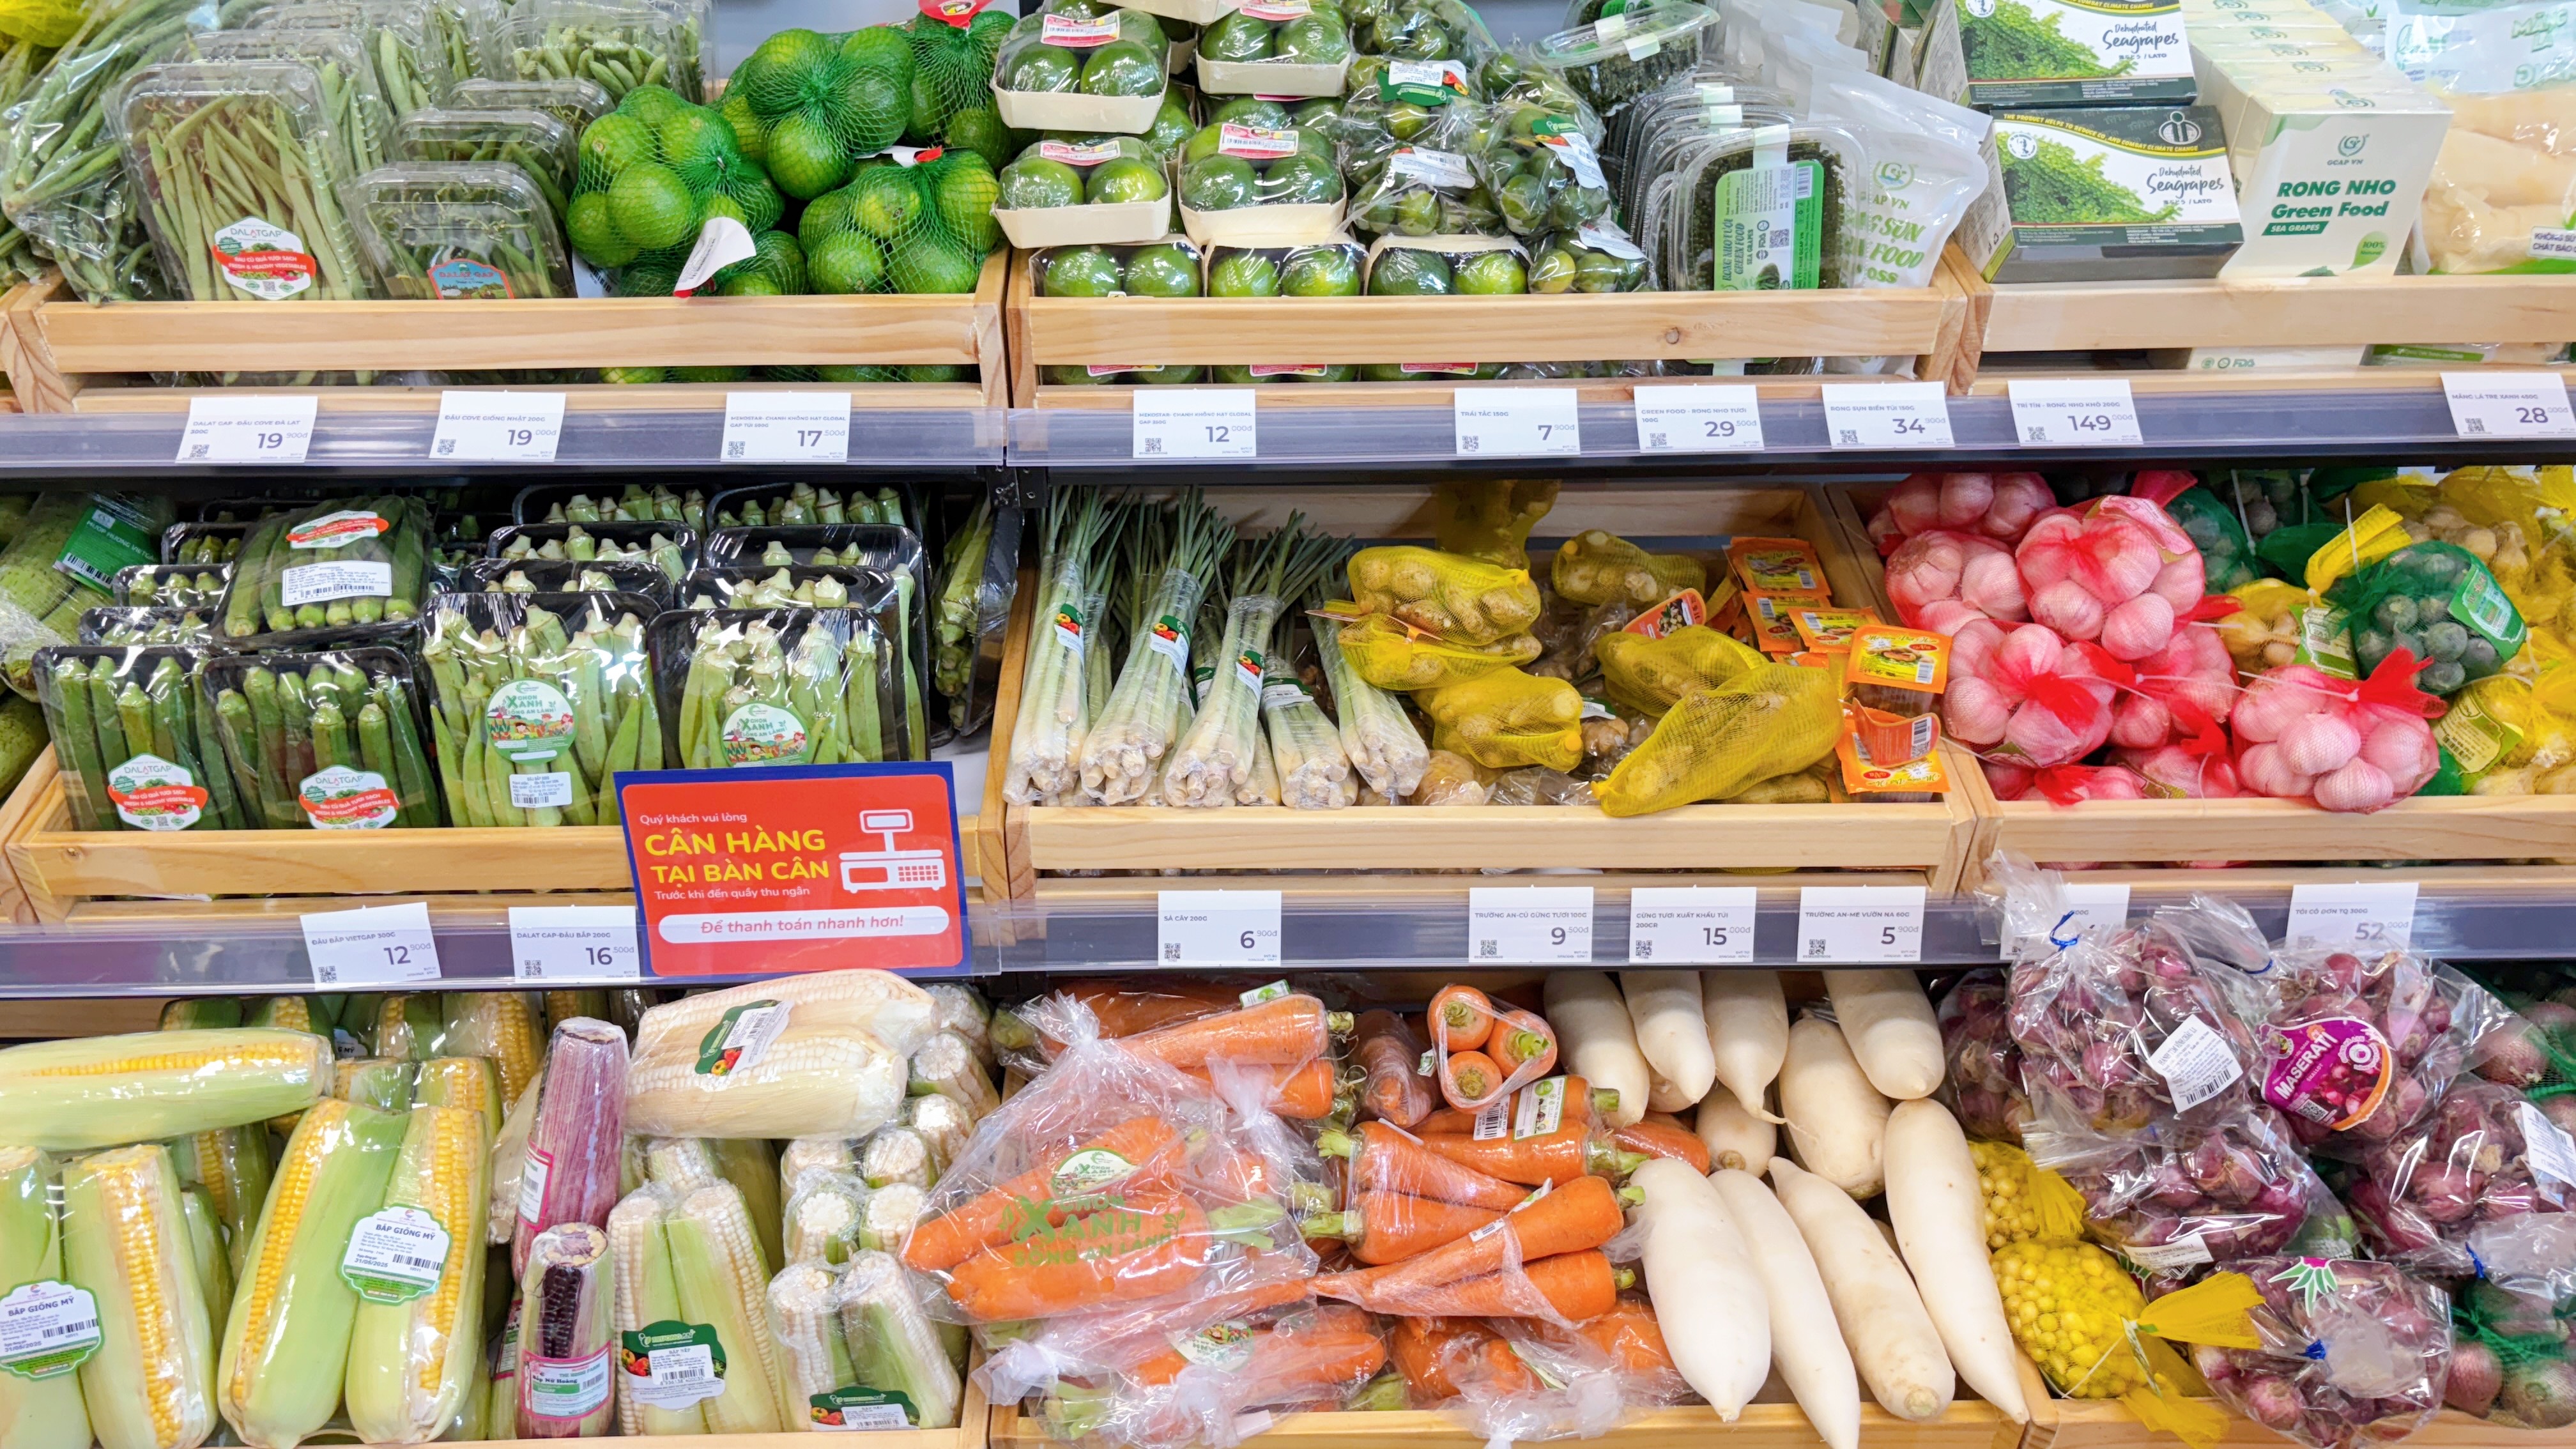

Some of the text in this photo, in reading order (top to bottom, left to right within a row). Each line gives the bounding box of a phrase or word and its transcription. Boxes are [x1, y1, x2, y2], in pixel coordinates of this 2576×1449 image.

[2115, 21, 2158, 33] Dehydrated
[2103, 30, 2179, 54] Seagrapes
[2159, 165, 2202, 178] Dehydrated
[2146, 173, 2224, 198] Seagrapes
[2276, 180, 2396, 197] RONG NHO
[2271, 201, 2389, 218] Green Food
[2288, 224, 2320, 232] GRAPES
[2067, 415, 2111, 431] 149
[2515, 408, 2549, 423] 28
[1206, 426, 1229, 442] 12
[1538, 425, 1552, 440] 7
[1704, 421, 1735, 437] 29
[1892, 418, 1925, 434] 34
[257, 433, 283, 448] 19
[508, 430, 532, 445] 19
[797, 431, 822, 447] 17
[640, 812, 747, 825] Quý khách vui lòng
[645, 825, 826, 856] CÂN HÀNG
[650, 857, 830, 887] TẠI BÀN CÂN
[654, 885, 810, 900] Trước khi đến quầy thu ngân
[701, 915, 904, 935] Để thanh toán nhanh hơn!
[1241, 931, 1255, 949] 6
[1551, 927, 1566, 945] 9
[1703, 928, 1727, 946] 15
[1881, 927, 1896, 944] 5
[384, 946, 411, 965] 12
[586, 947, 613, 965] 16
[2274, 1031, 2338, 1100] MASERATI
